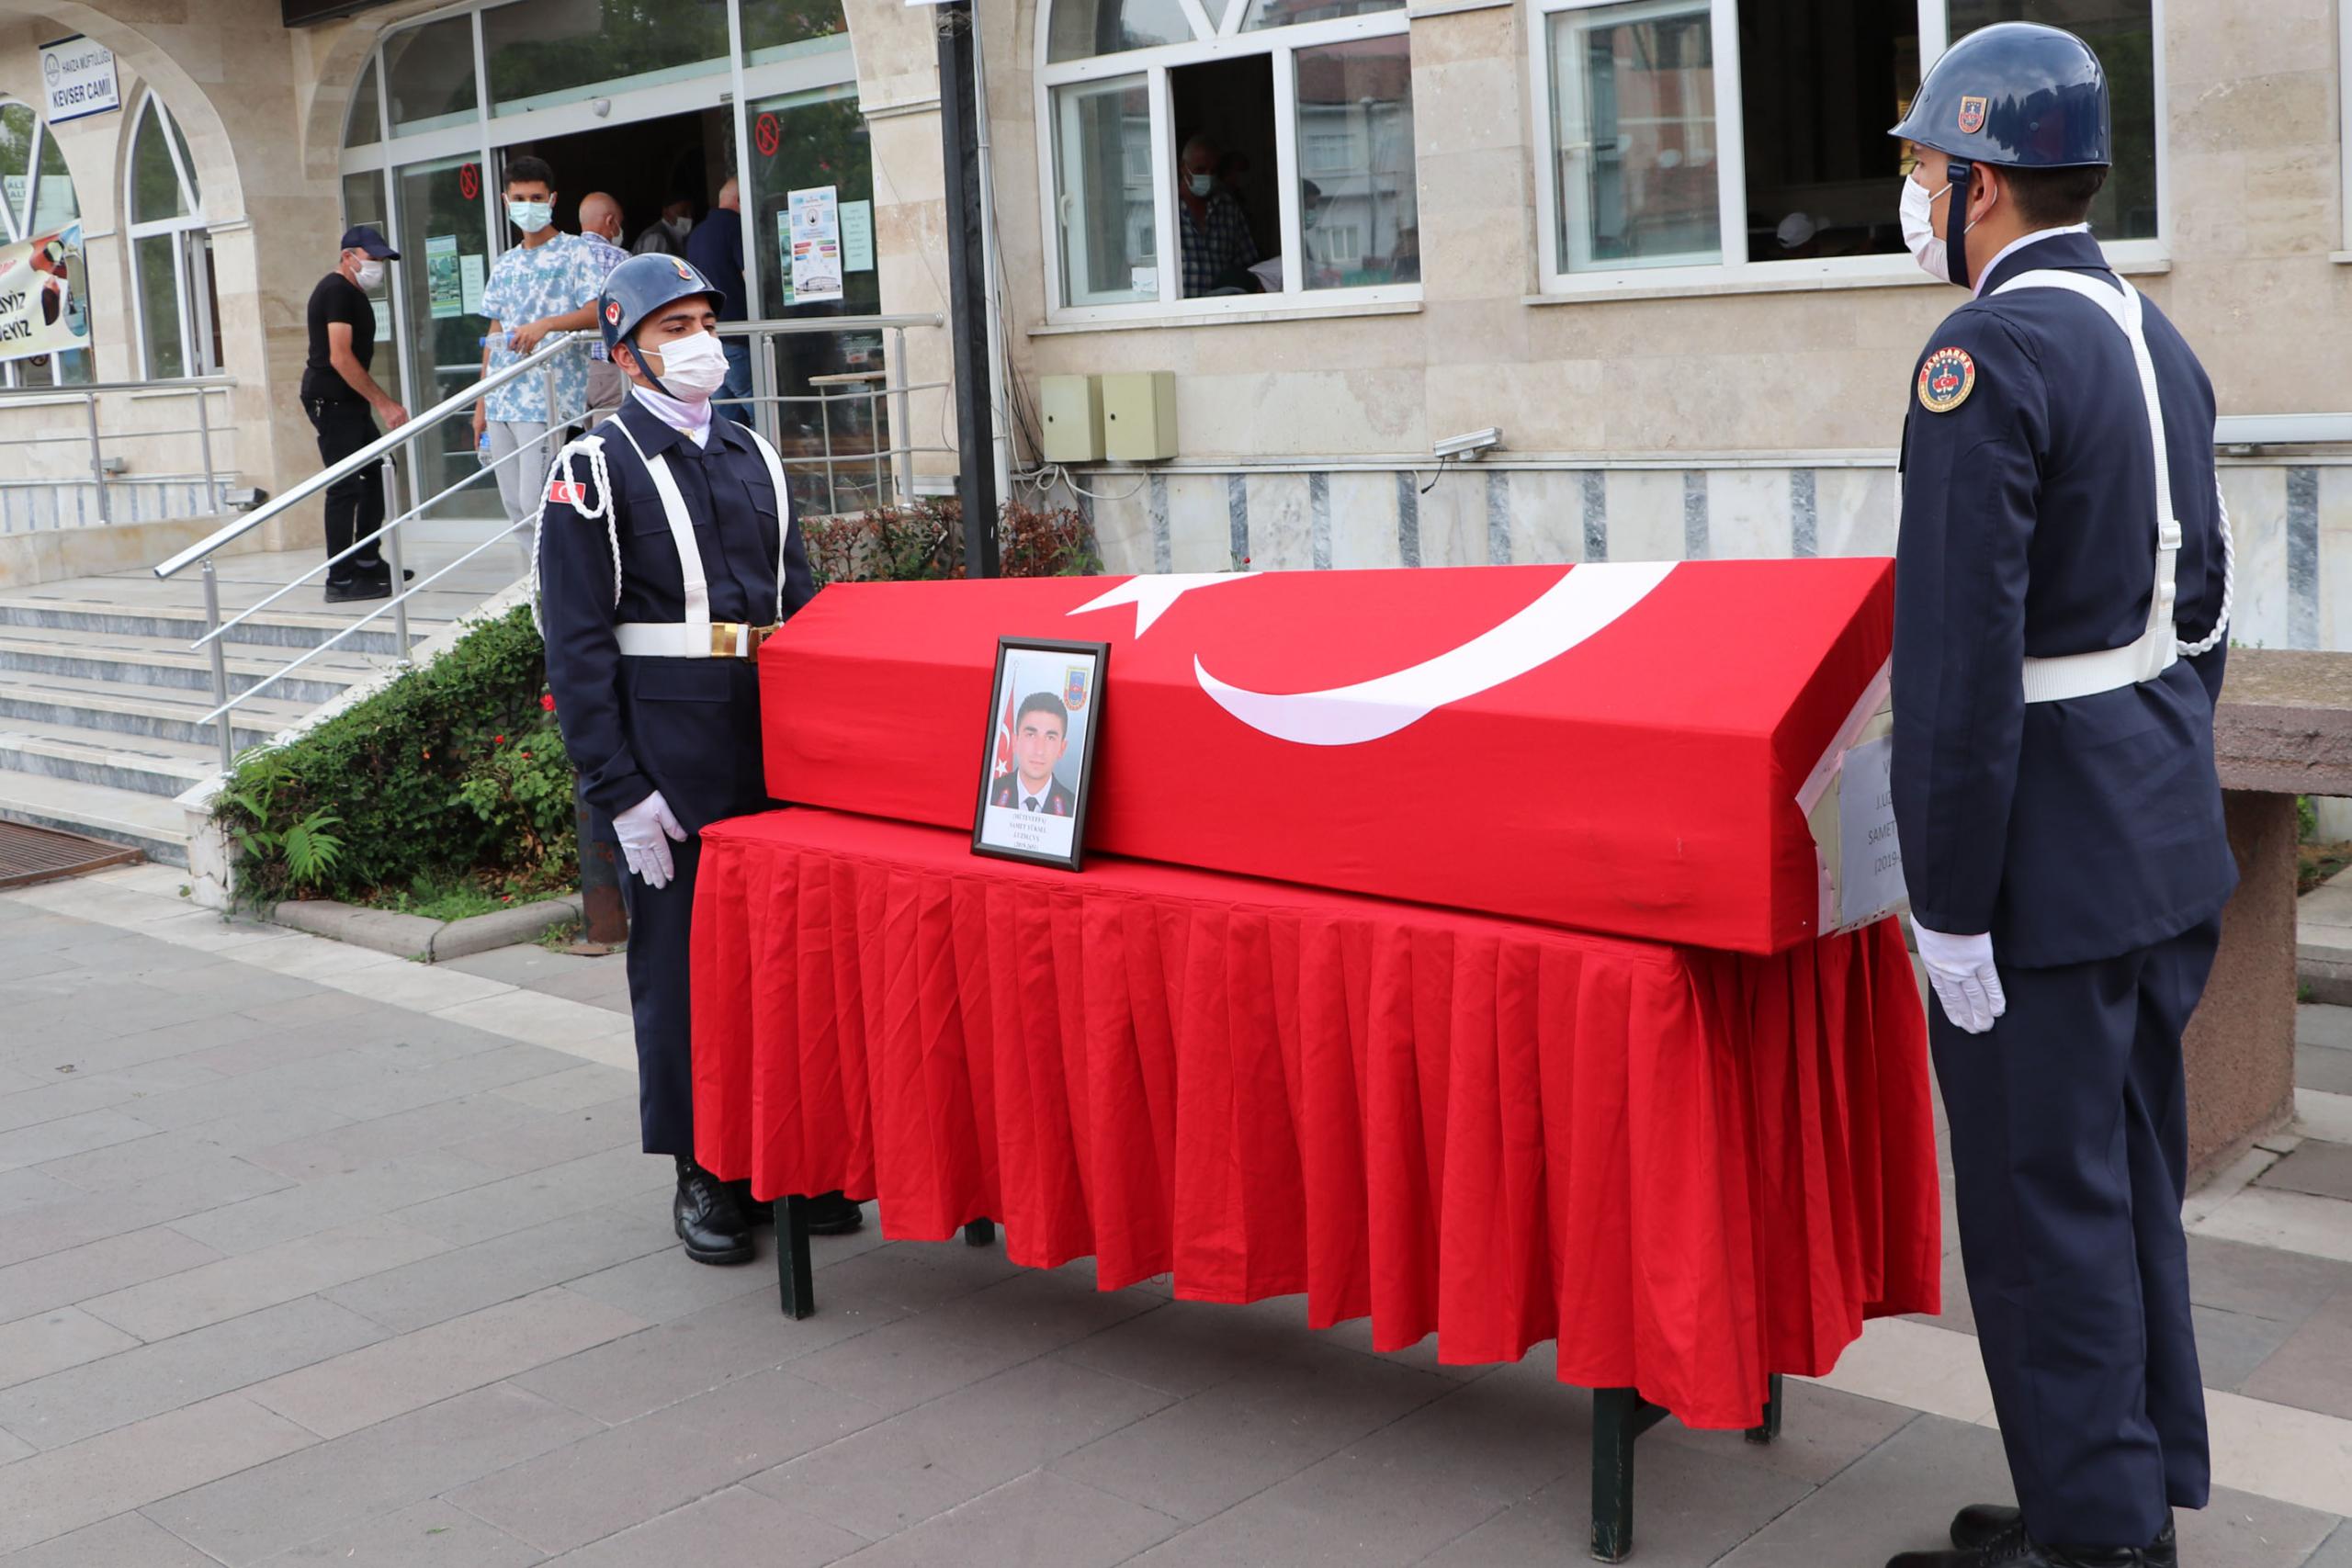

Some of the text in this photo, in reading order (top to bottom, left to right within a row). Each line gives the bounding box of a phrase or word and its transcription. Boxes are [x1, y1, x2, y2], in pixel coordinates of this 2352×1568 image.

[52, 85, 85, 108] KEVSER
[1923, 348, 1972, 376] JANDARMA
[1868, 819, 1896, 845] SAMET
[1875, 851, 1901, 875] (2019-
